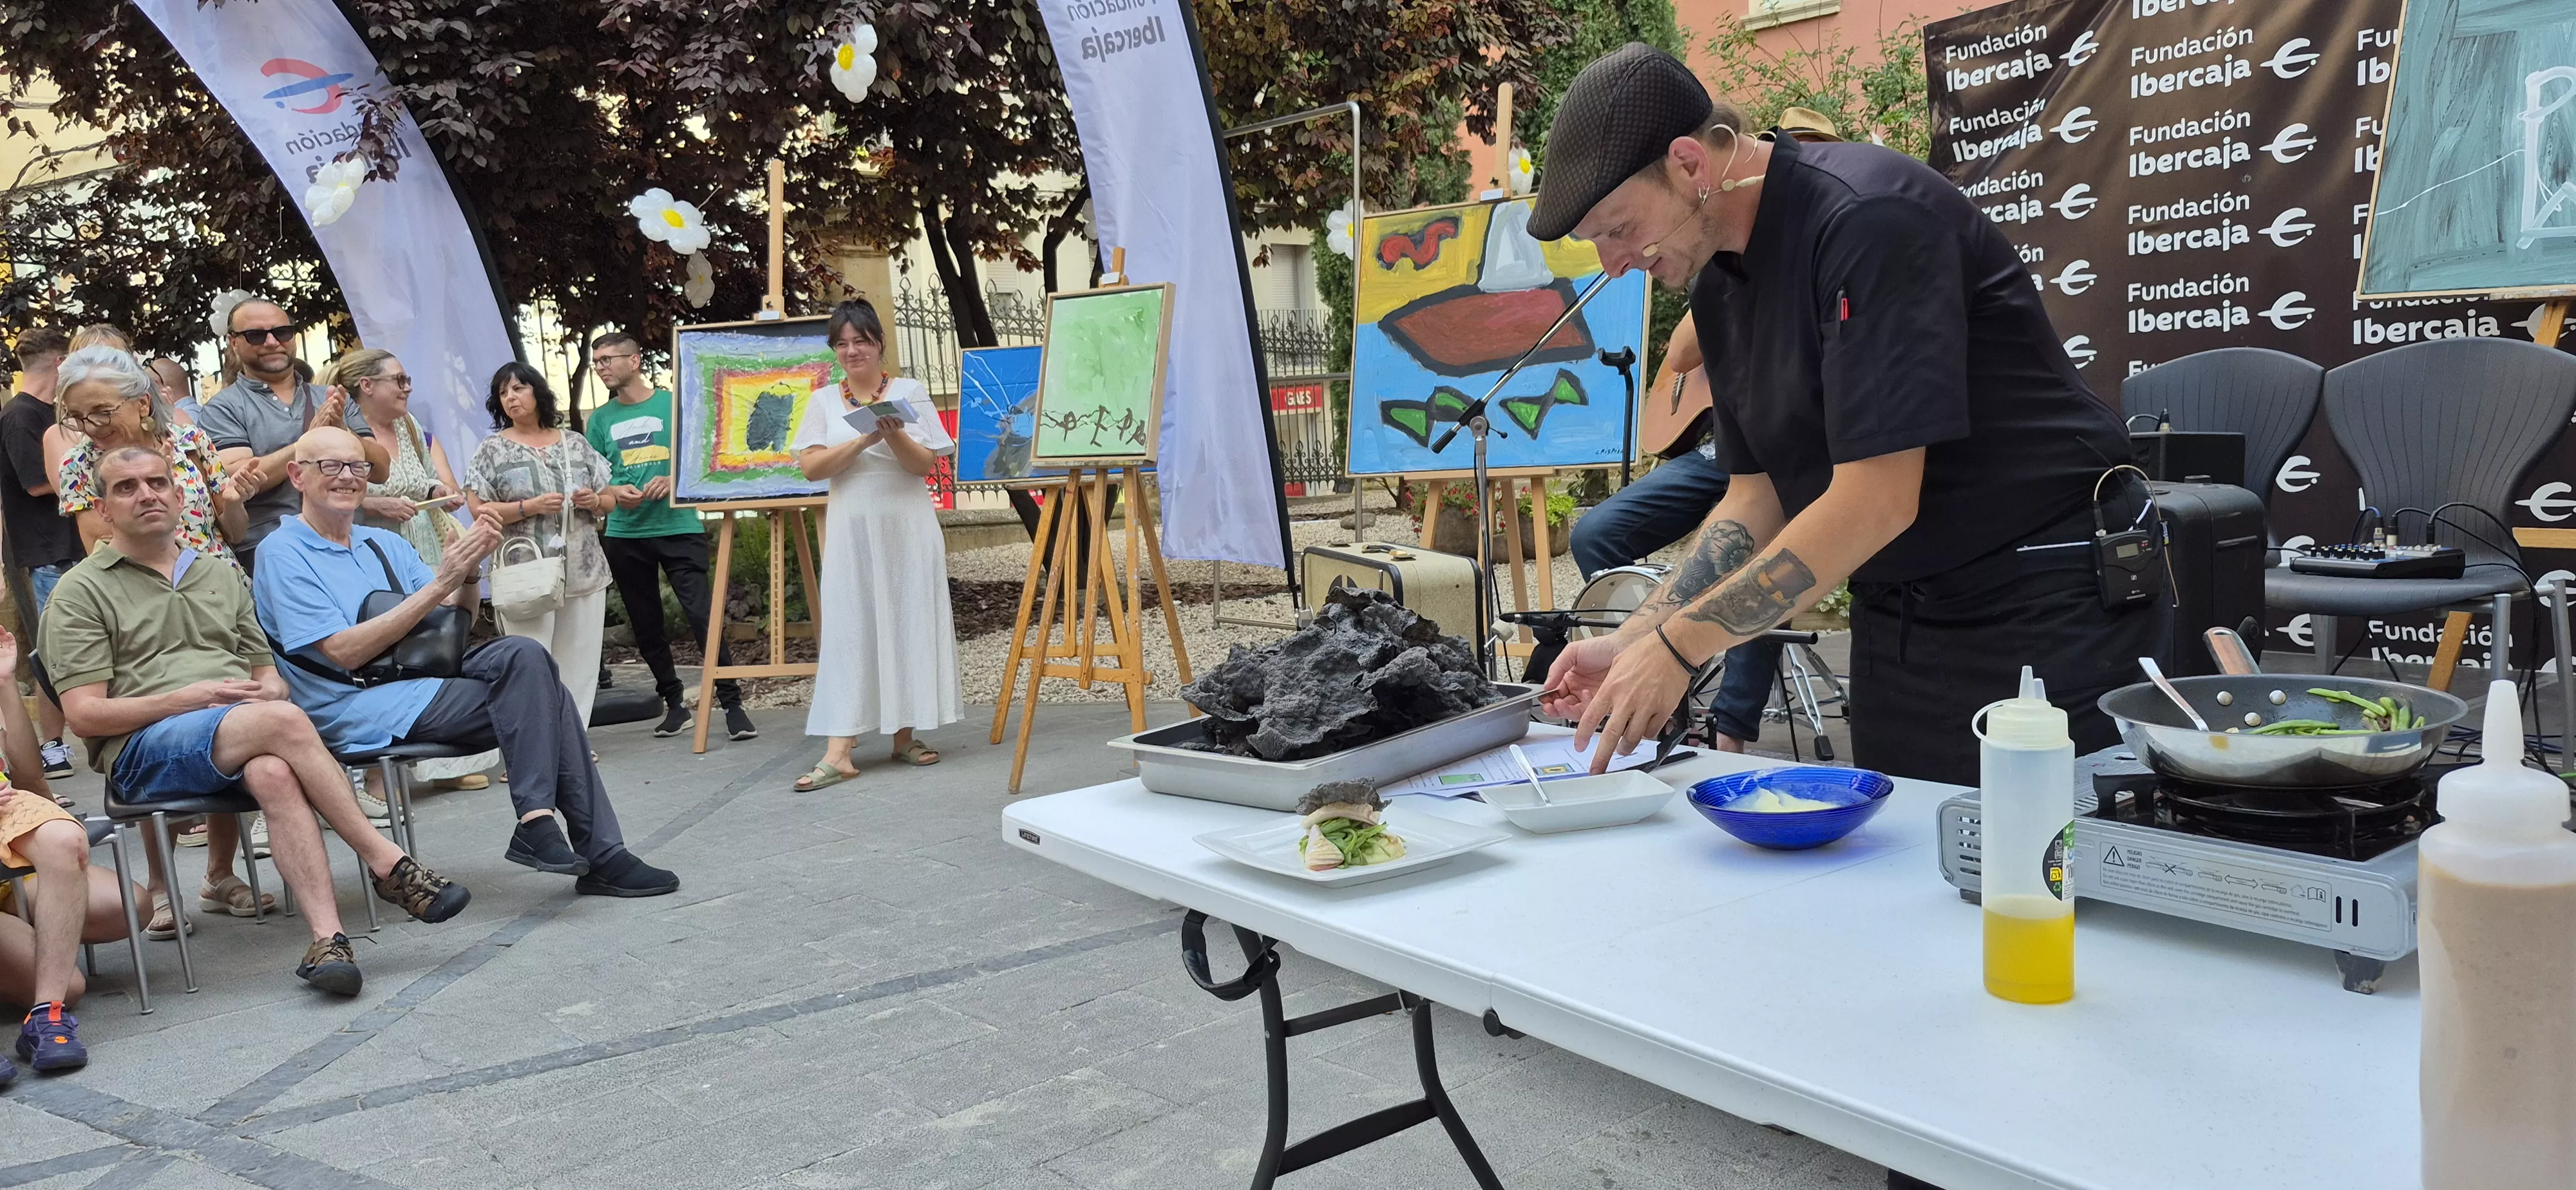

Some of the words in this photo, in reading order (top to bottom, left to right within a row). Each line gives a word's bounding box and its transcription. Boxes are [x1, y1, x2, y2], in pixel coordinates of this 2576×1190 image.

[1946, 23, 2047, 64] Fundación
[2130, 26, 2254, 67] Fundación
[1946, 48, 2052, 93] Ibercaja
[2130, 54, 2252, 99] Ibercaja
[1949, 97, 2046, 135] Fundación
[2129, 109, 2251, 146] Fundación
[2129, 136, 2251, 178] Ibercaja
[2128, 191, 2250, 225] Fundación
[2128, 218, 2250, 256] Ibercaja
[2128, 273, 2249, 303] Fundación
[2128, 299, 2249, 334] Ibercaja
[2353, 308, 2501, 345] Ibercaja
[629, 431, 650, 445] and
